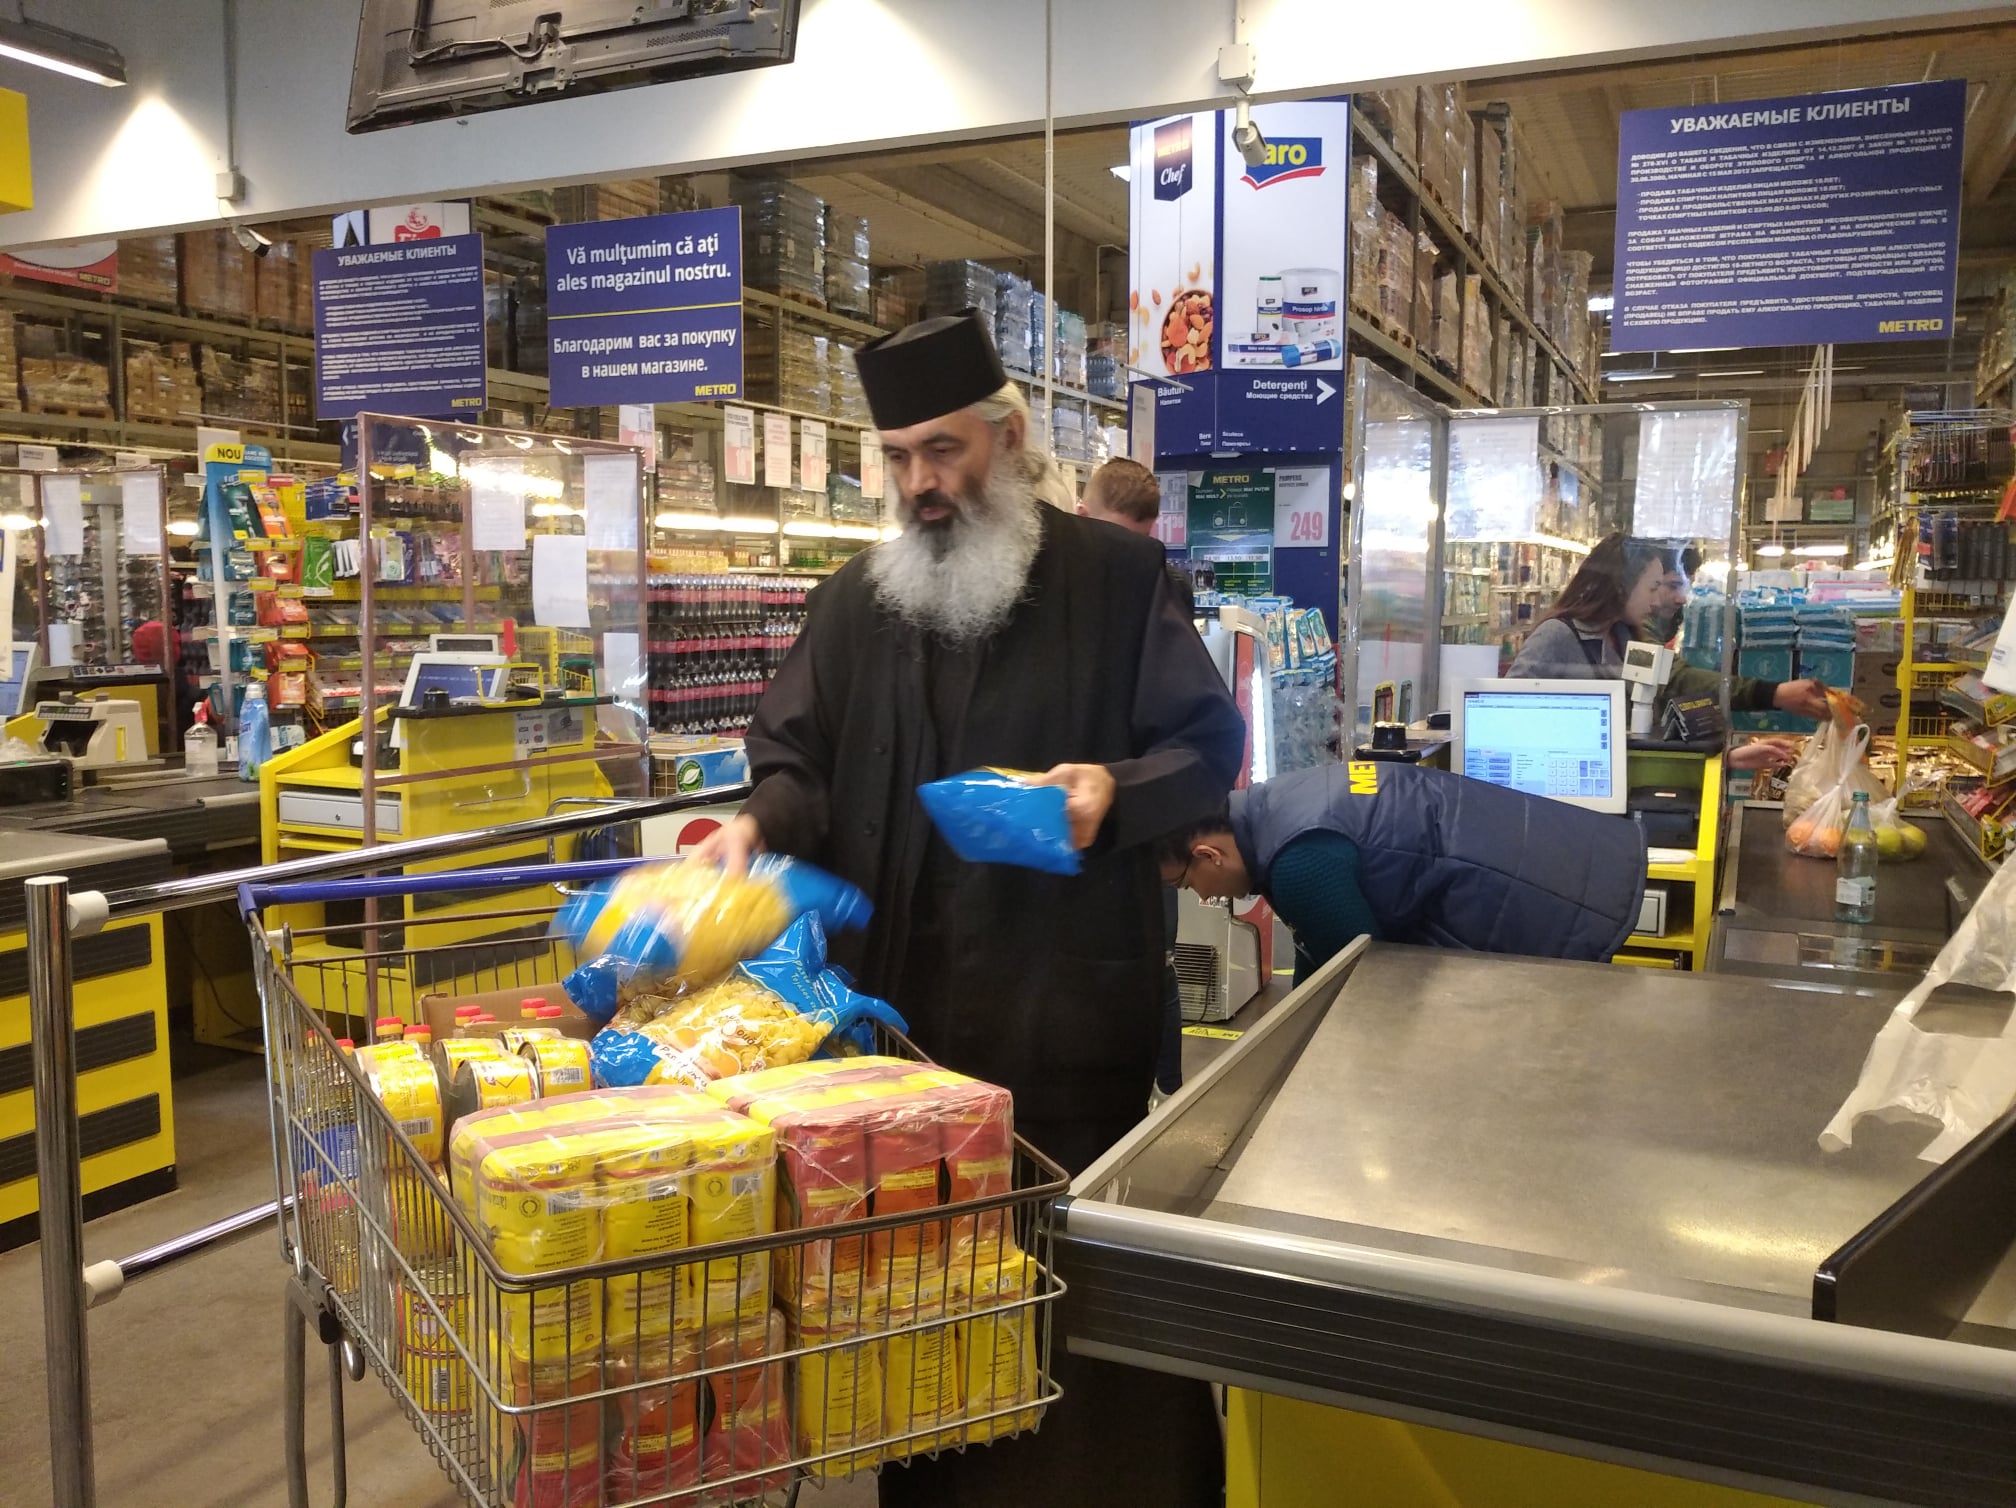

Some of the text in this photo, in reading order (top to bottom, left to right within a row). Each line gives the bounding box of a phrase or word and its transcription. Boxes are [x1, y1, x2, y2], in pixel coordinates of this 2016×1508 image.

[1670, 97, 1911, 133] УВАЖАЕМЫЕ КЛИЕНТЫ
[1263, 143, 1307, 165] aro
[1161, 164, 1186, 186] Chef
[338, 245, 457, 267] УВАЖАЕМЫЕ КЛИЕНТЫ
[567, 247, 586, 265] Vă
[676, 235, 693, 255] că
[557, 262, 731, 292] ales magazinul nostru.
[1879, 319, 1943, 333] METRO
[553, 328, 737, 354] Благодарим вас за покупку
[581, 358, 708, 378] в нашем магазине.
[694, 383, 737, 396] METRO
[1246, 392, 1278, 400] Моющие
[451, 397, 482, 408] METRO
[217, 448, 241, 459] NOU
[1213, 475, 1249, 484] METRO
[1291, 511, 1323, 541] 249
